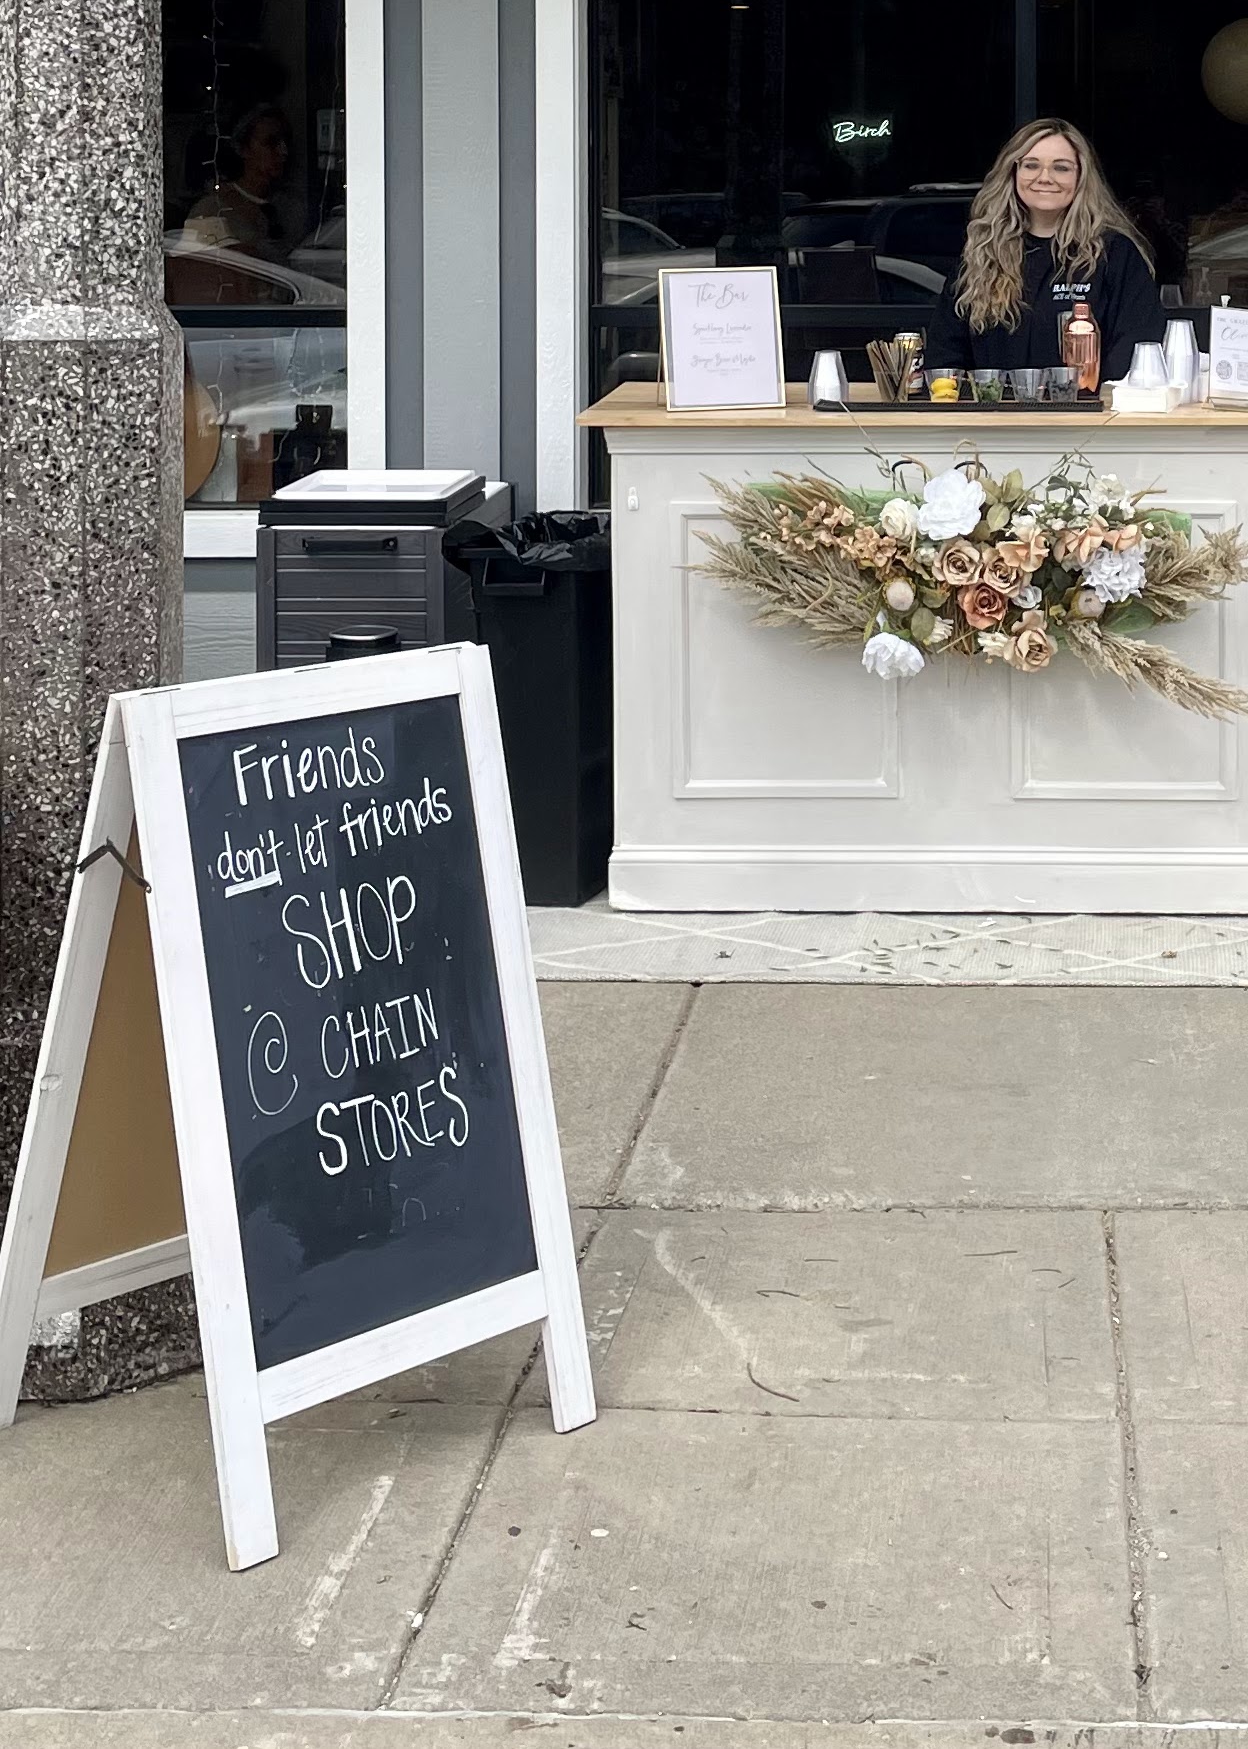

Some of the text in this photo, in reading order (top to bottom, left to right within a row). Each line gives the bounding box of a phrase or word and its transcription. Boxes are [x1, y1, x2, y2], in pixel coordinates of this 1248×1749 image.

[833, 119, 892, 143] Birch
[233, 727, 386, 806] Friends
[295, 813, 331, 875] let
[339, 777, 453, 856] friends
[281, 875, 416, 990] SHOP
[320, 988, 439, 1080] CHAIN
[315, 1066, 470, 1176] STORES
